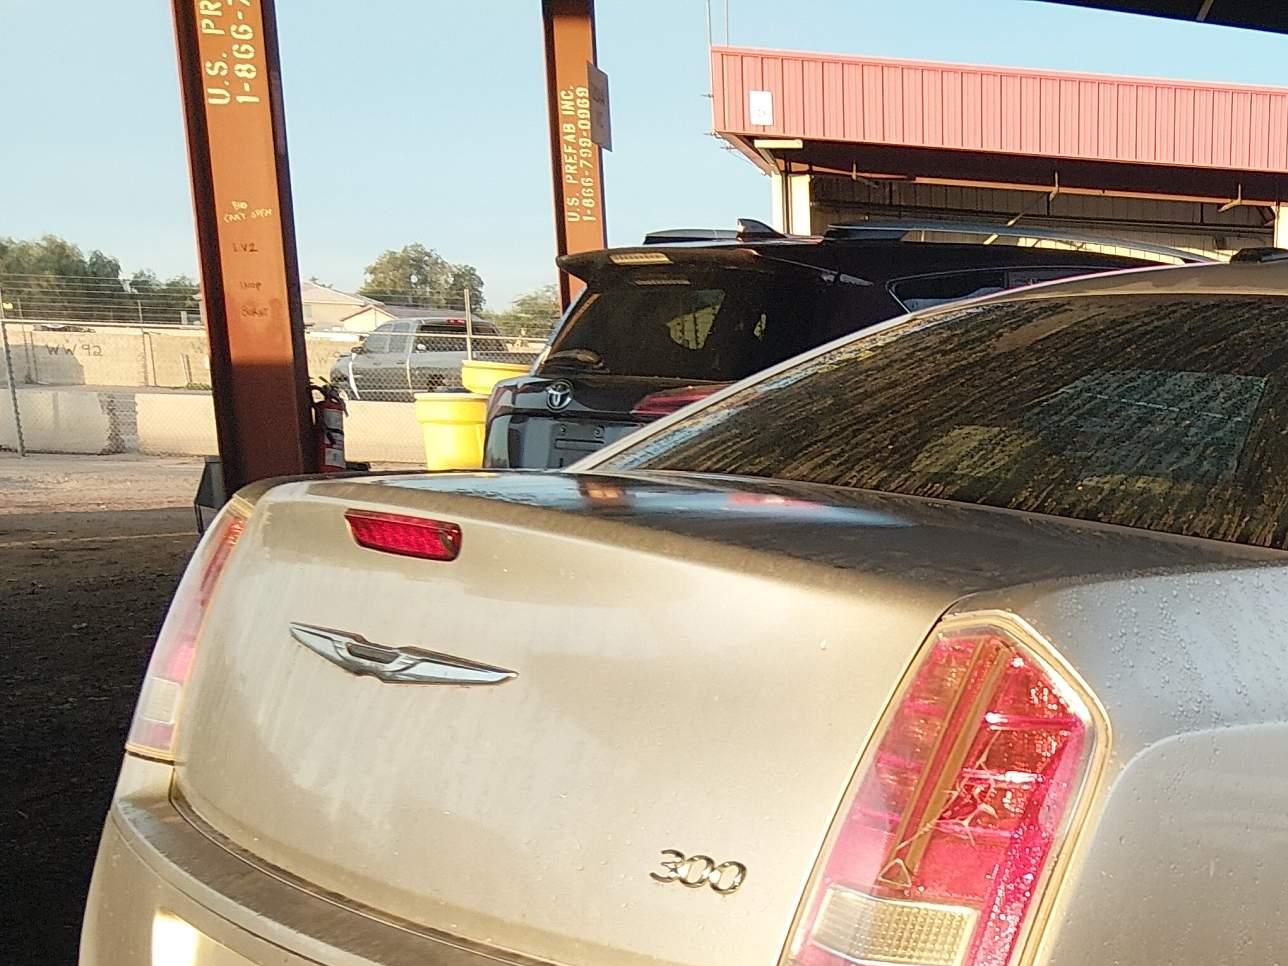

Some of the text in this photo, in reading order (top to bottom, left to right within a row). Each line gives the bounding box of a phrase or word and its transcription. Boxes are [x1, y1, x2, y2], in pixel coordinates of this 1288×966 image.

[205, 52, 231, 105] U.S.
[560, 85, 581, 222] U.S. PREFAB INC.
[575, 87, 597, 222] 1-866-799-0969
[649, 849, 747, 895] 300
